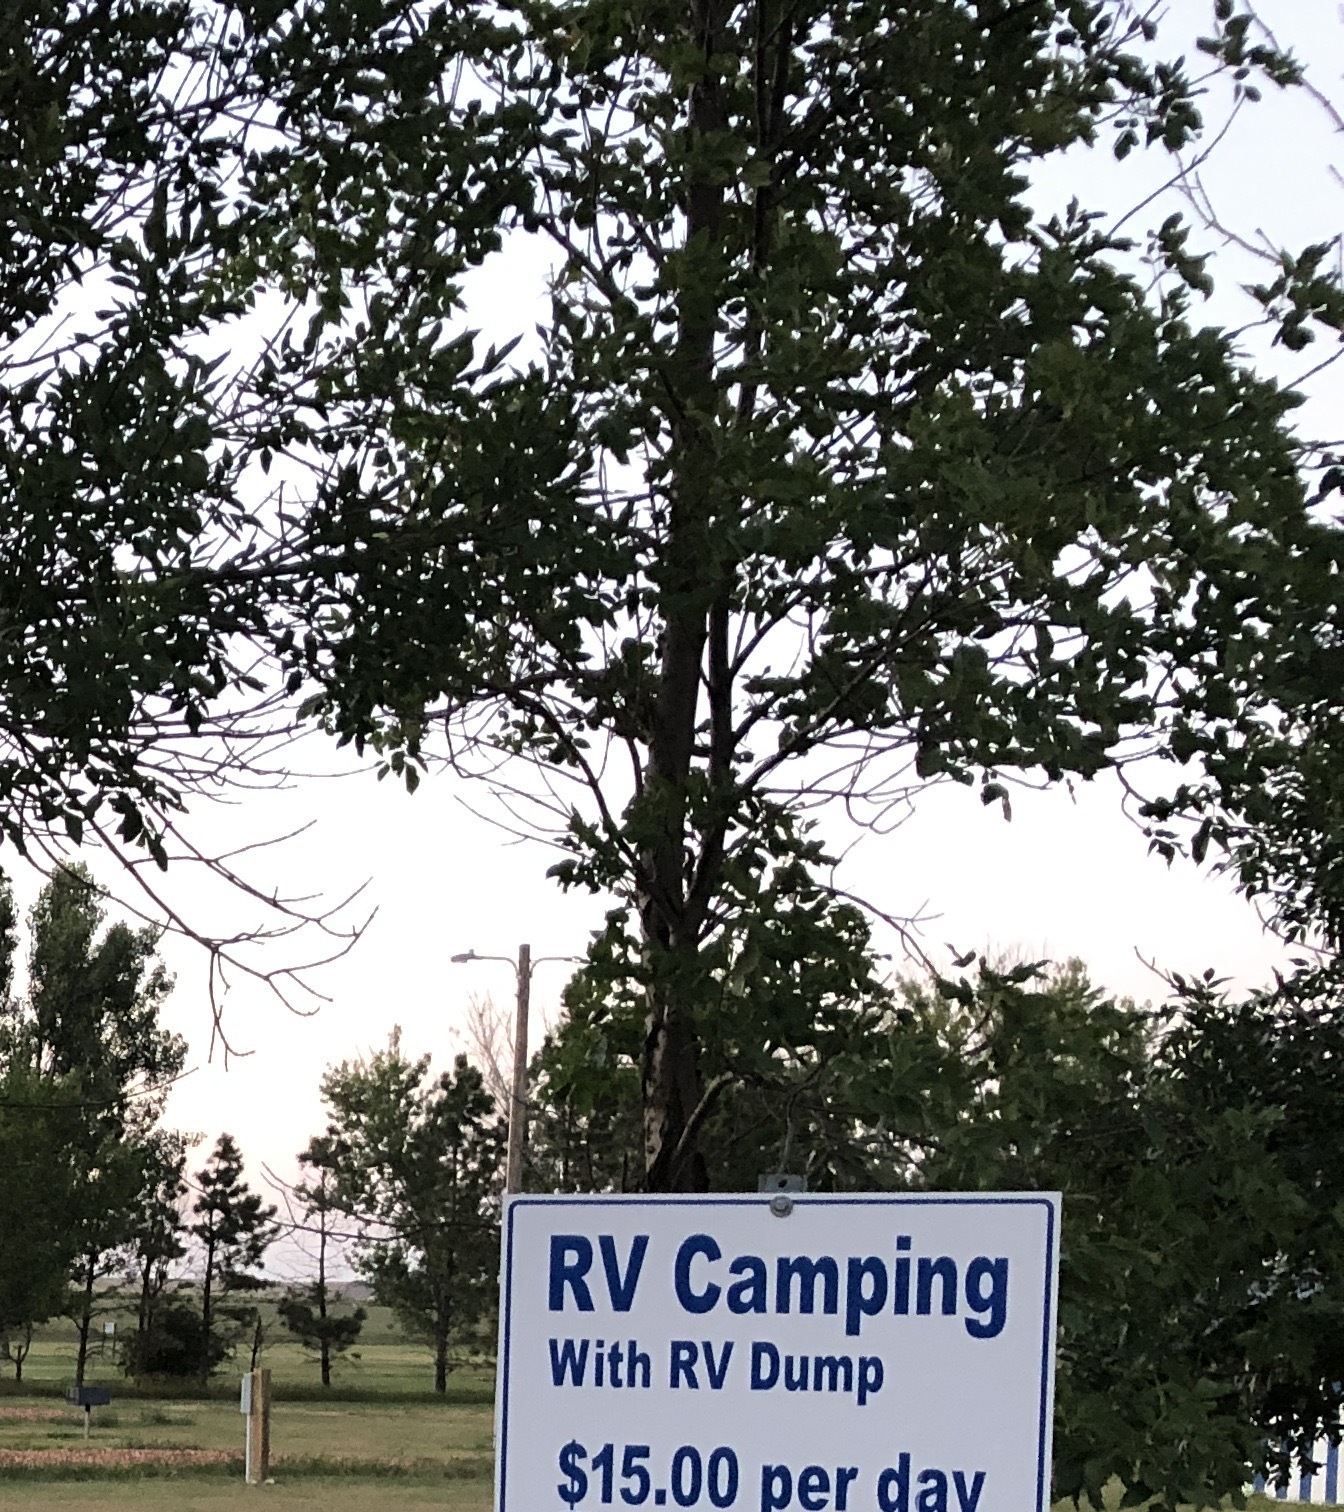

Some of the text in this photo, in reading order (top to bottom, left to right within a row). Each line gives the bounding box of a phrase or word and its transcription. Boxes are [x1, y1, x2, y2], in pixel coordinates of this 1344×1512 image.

[548, 1232, 1010, 1339] RV Camping
[548, 1337, 885, 1407] With RV Dump
[556, 1439, 740, 1510] $15.00
